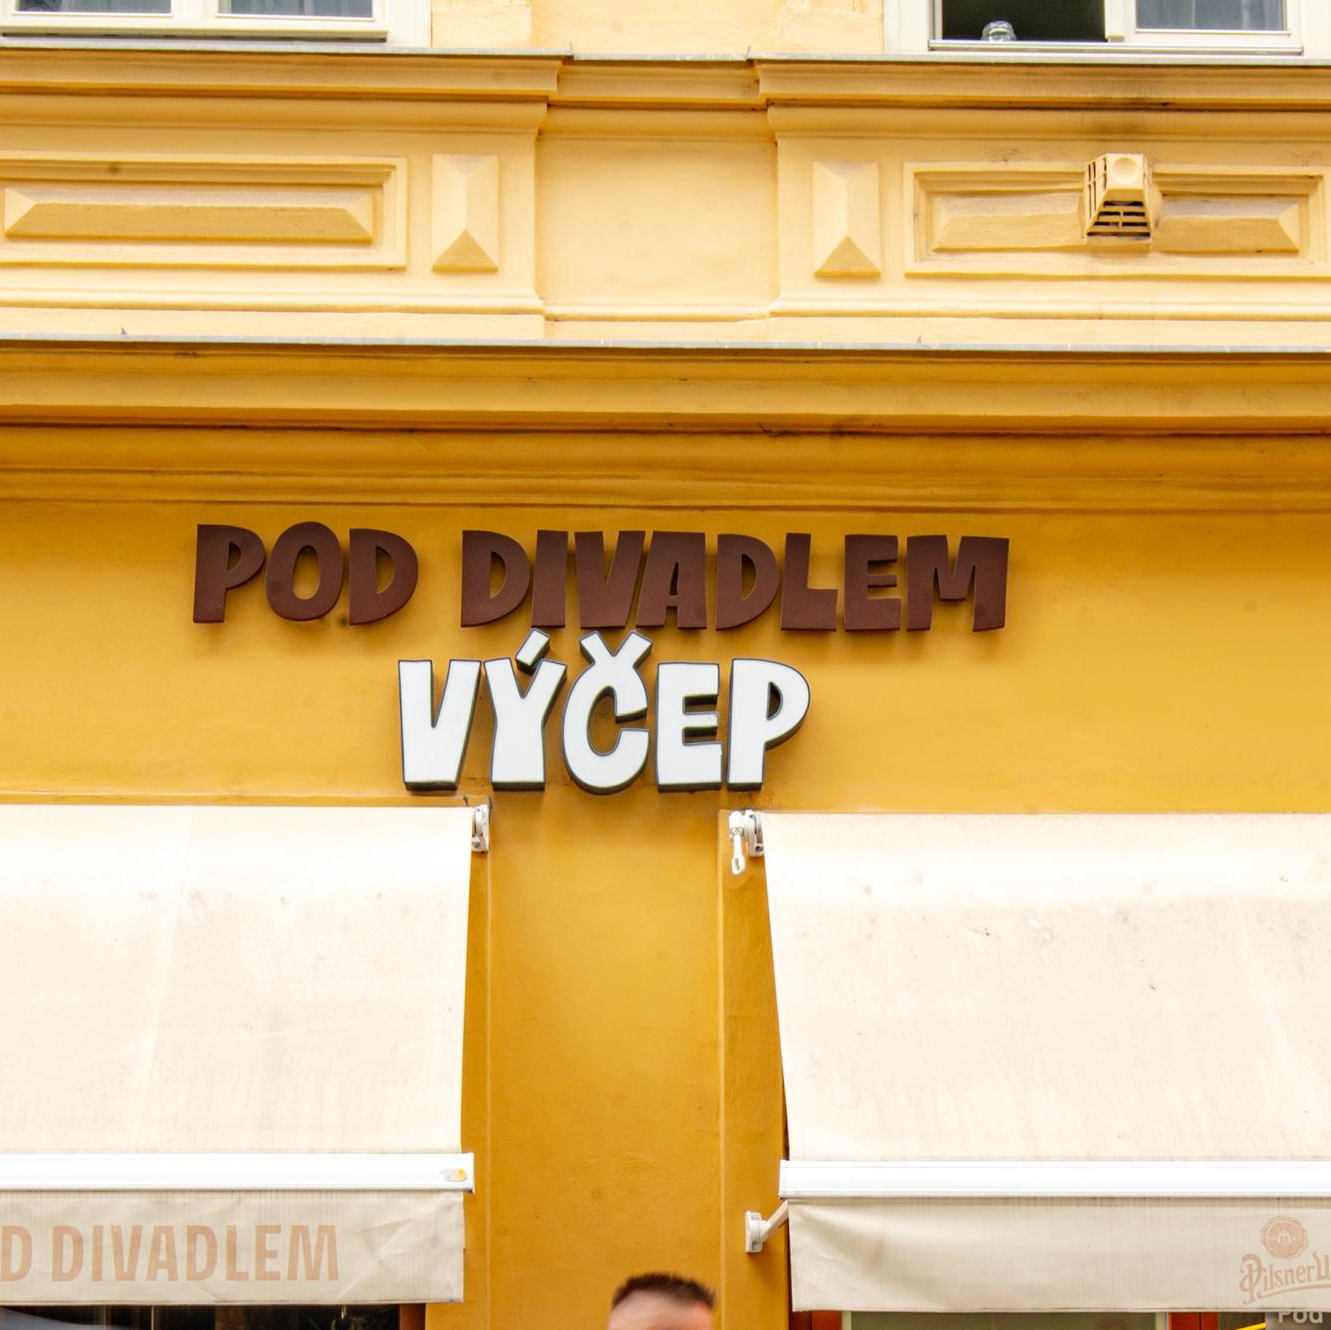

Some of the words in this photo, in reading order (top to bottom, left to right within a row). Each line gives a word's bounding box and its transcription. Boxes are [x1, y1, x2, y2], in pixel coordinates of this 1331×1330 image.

[193, 521, 419, 626] POD
[461, 527, 1010, 633] DIVADLEM
[398, 629, 811, 793] VÝČEP
[51, 1224, 339, 1283] DIVADLEM
[1239, 1252, 1316, 1306] Pilsner
[1278, 1311, 1324, 1325] Pod
